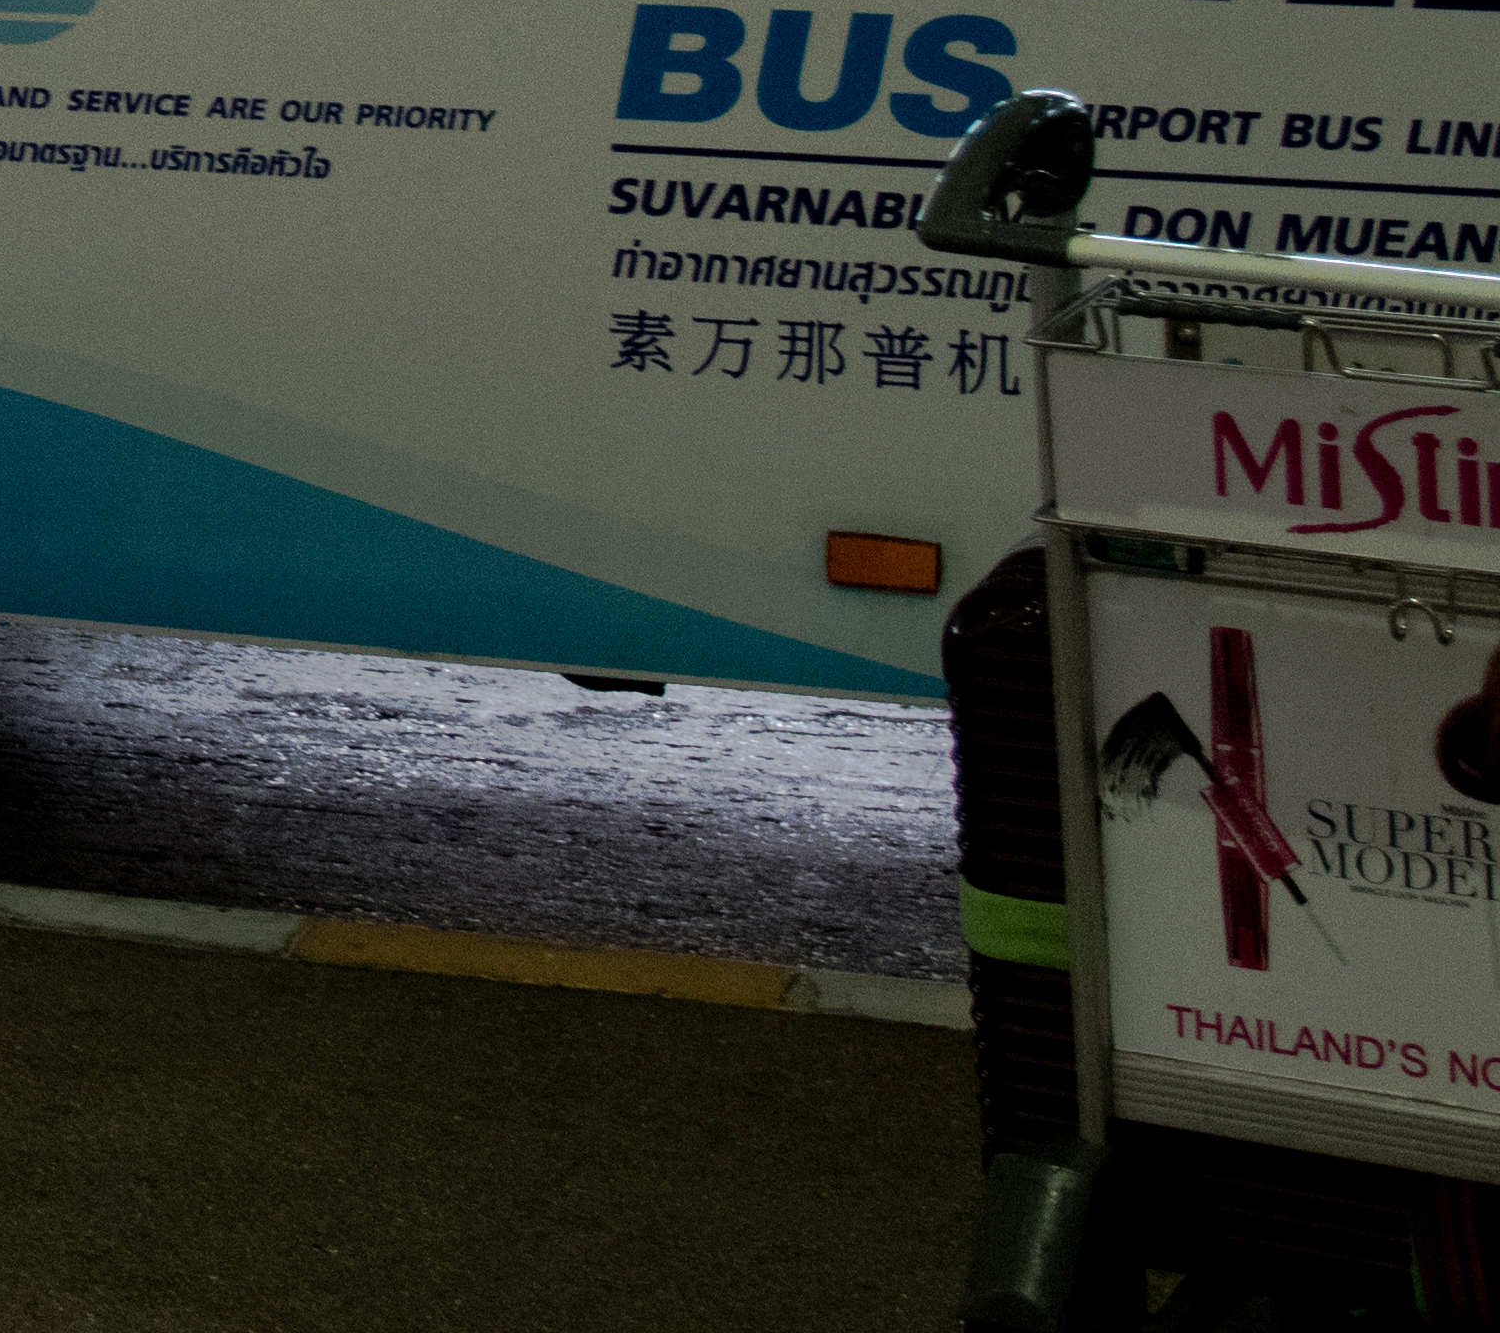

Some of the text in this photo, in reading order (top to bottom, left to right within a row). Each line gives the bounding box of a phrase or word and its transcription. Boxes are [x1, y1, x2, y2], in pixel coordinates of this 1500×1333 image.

[616, 5, 1019, 138] BUS
[67, 90, 191, 116] SERVICE
[206, 97, 267, 120] ARE
[280, 100, 343, 124] OUR
[356, 104, 496, 132] PRIORITY
[1090, 103, 1500, 158] IRPORT BUS LIN
[1123, 205, 1252, 252] DON
[1276, 214, 1500, 263] MUEAN
[609, 310, 1022, 396] 素万那普机
[1307, 799, 1496, 864] SUPER
[1167, 1004, 1428, 1078] THAILAND'S
